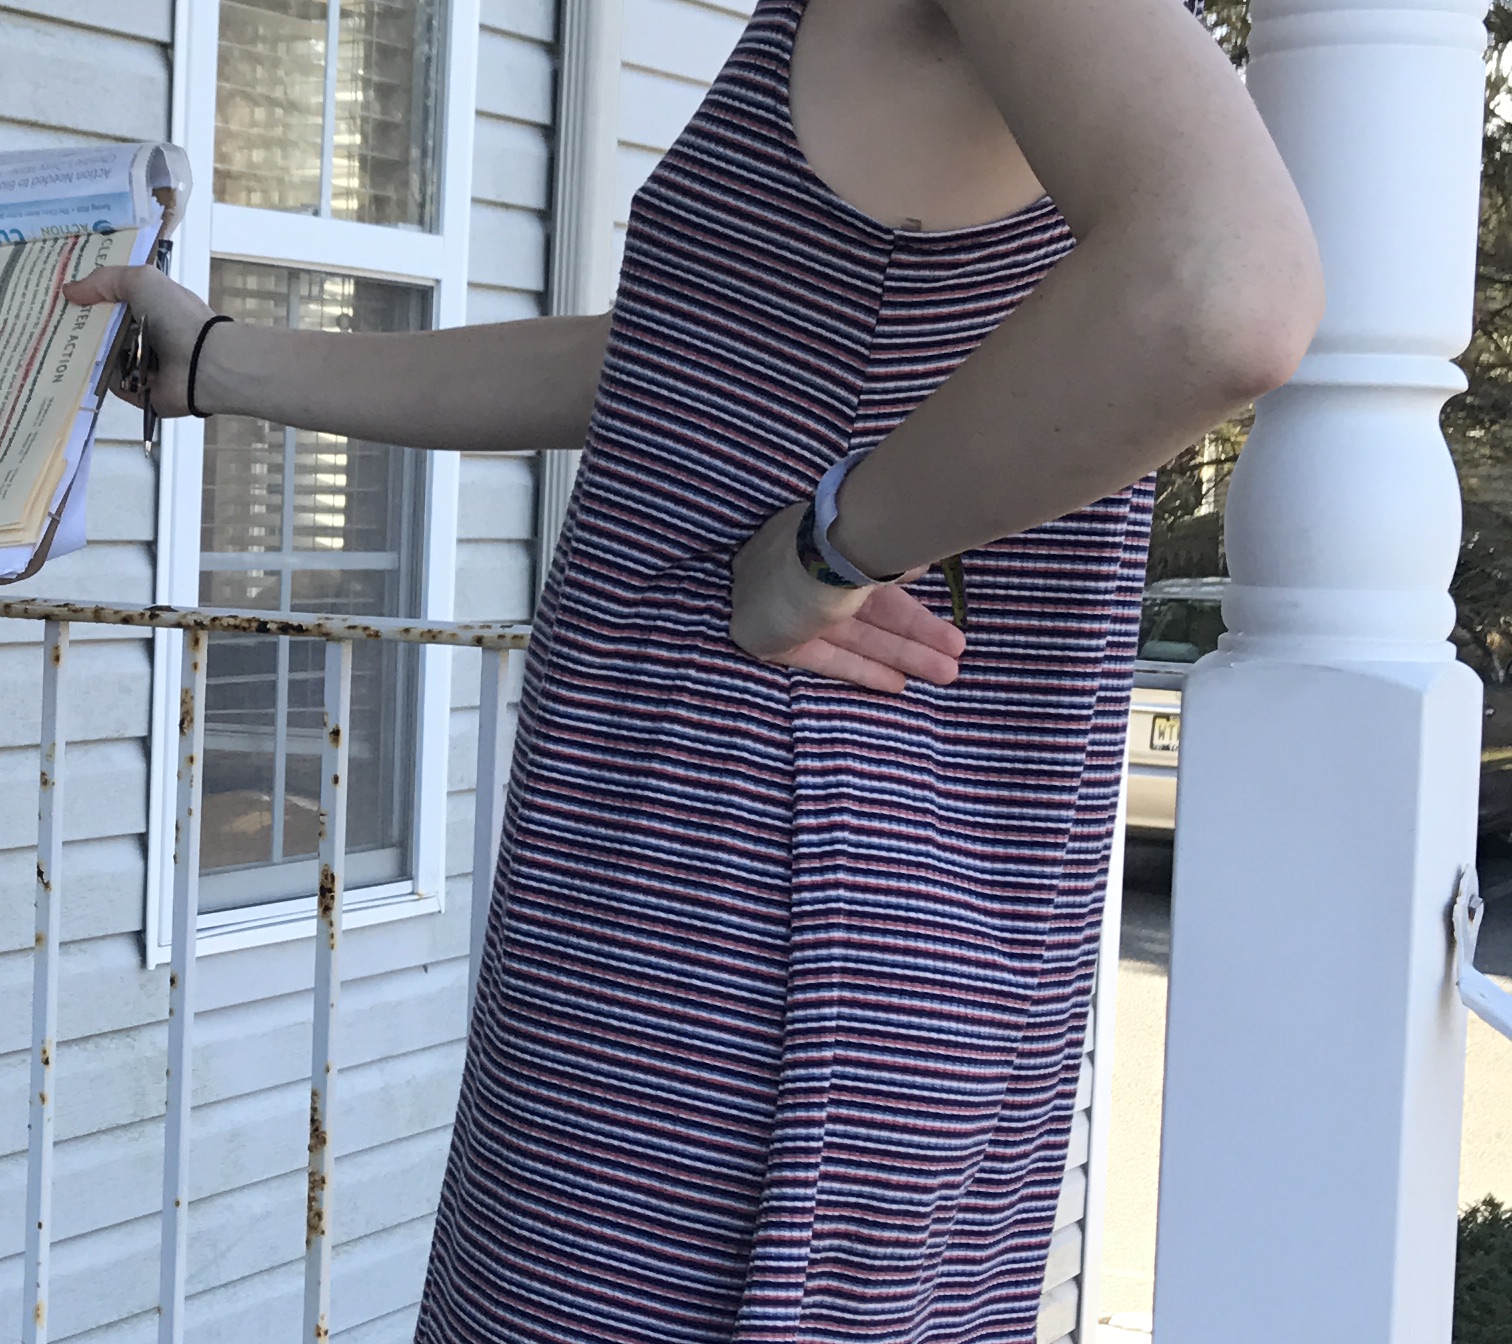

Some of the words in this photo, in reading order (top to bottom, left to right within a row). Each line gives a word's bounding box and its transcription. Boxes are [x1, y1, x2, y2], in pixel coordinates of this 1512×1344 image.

[40, 222, 88, 237] ACTION
[93, 238, 114, 267] CLE
[52, 334, 76, 384] ACTION
